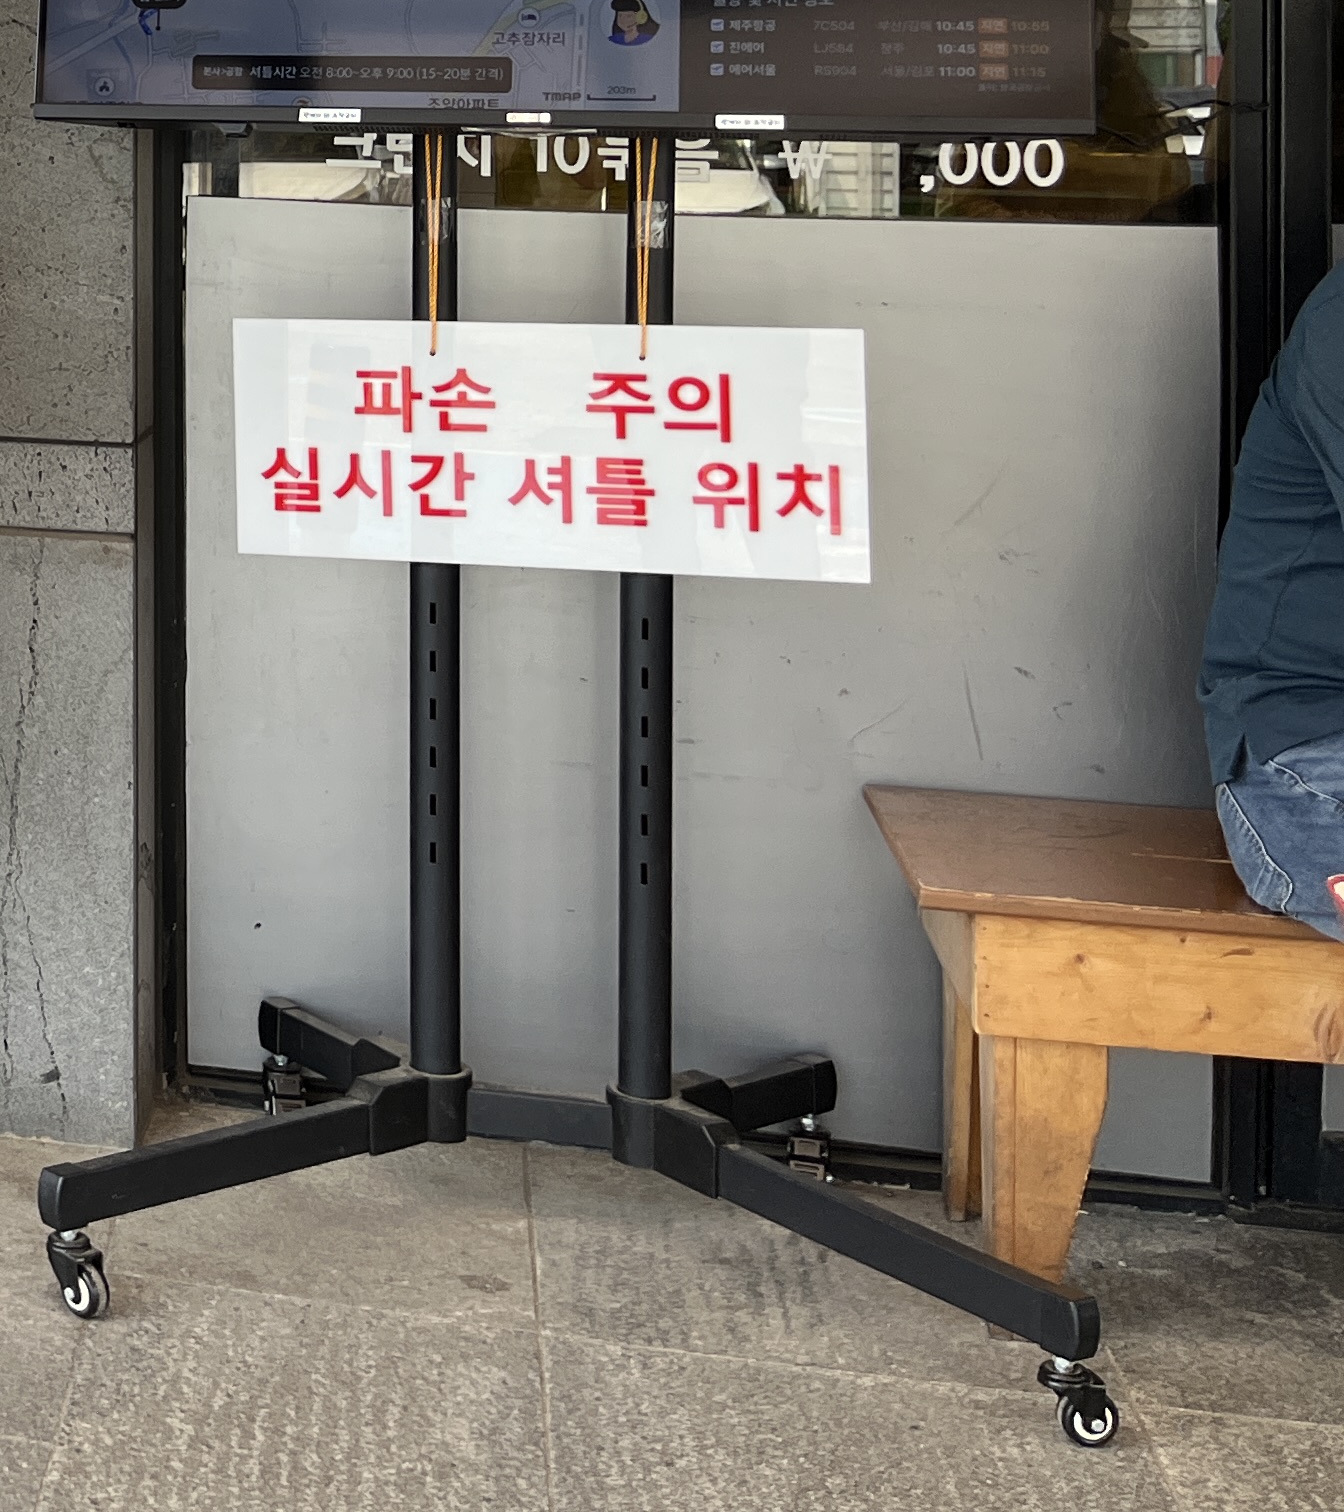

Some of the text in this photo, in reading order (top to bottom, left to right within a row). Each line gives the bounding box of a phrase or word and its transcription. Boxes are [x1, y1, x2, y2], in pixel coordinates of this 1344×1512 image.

[728, 19, 777, 32] 제주항공
[935, 20, 975, 32] 10:45
[492, 32, 566, 46] 고추잠자리
[728, 41, 765, 54] 진에어
[936, 43, 976, 55] 10:45
[249, 65, 297, 80] 셔틀시간
[299, 66, 323, 79] 오전
[325, 65, 383, 80] 8:00~오후
[386, 66, 414, 80] 9:00
[474, 66, 505, 81] 간격)
[728, 63, 777, 76] 에어서울
[938, 65, 976, 78] 11:00
[542, 92, 582, 102] TMAP
[606, 85, 637, 95] 203m
[353, 364, 734, 443] 파손 주의
[261, 445, 843, 536] 실시간 셔틀 위치
